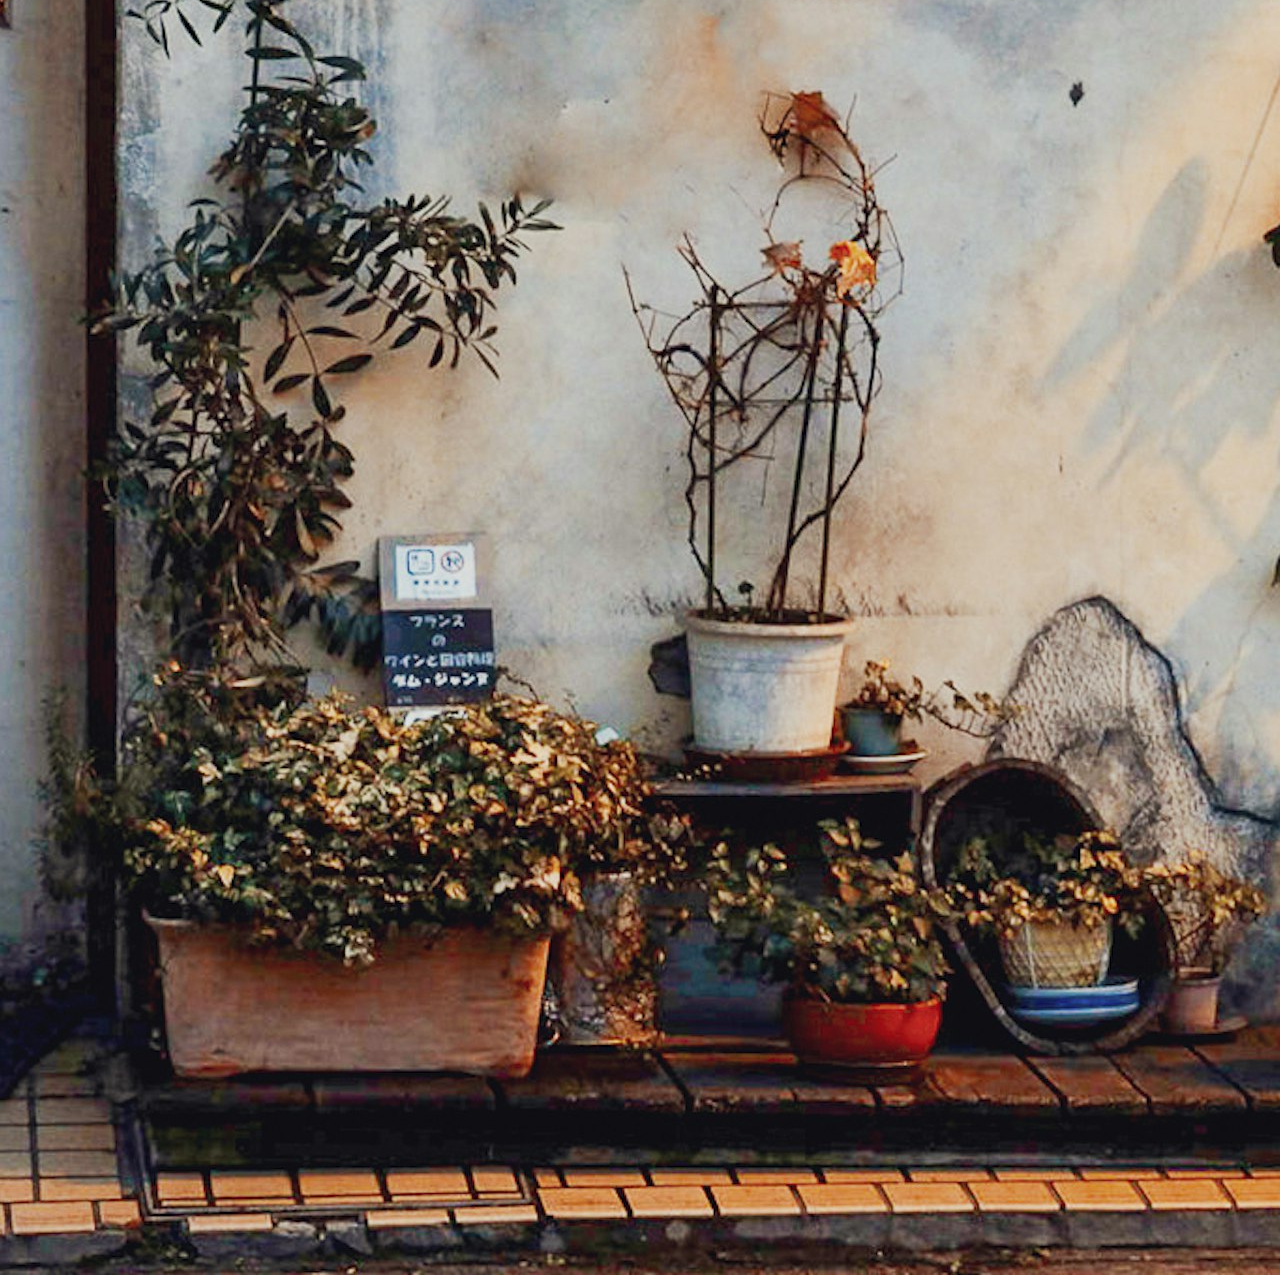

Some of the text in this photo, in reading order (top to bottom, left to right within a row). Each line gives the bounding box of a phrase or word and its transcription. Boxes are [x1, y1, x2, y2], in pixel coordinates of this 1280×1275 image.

[409, 614, 465, 628] フランス
[431, 633, 446, 647] の
